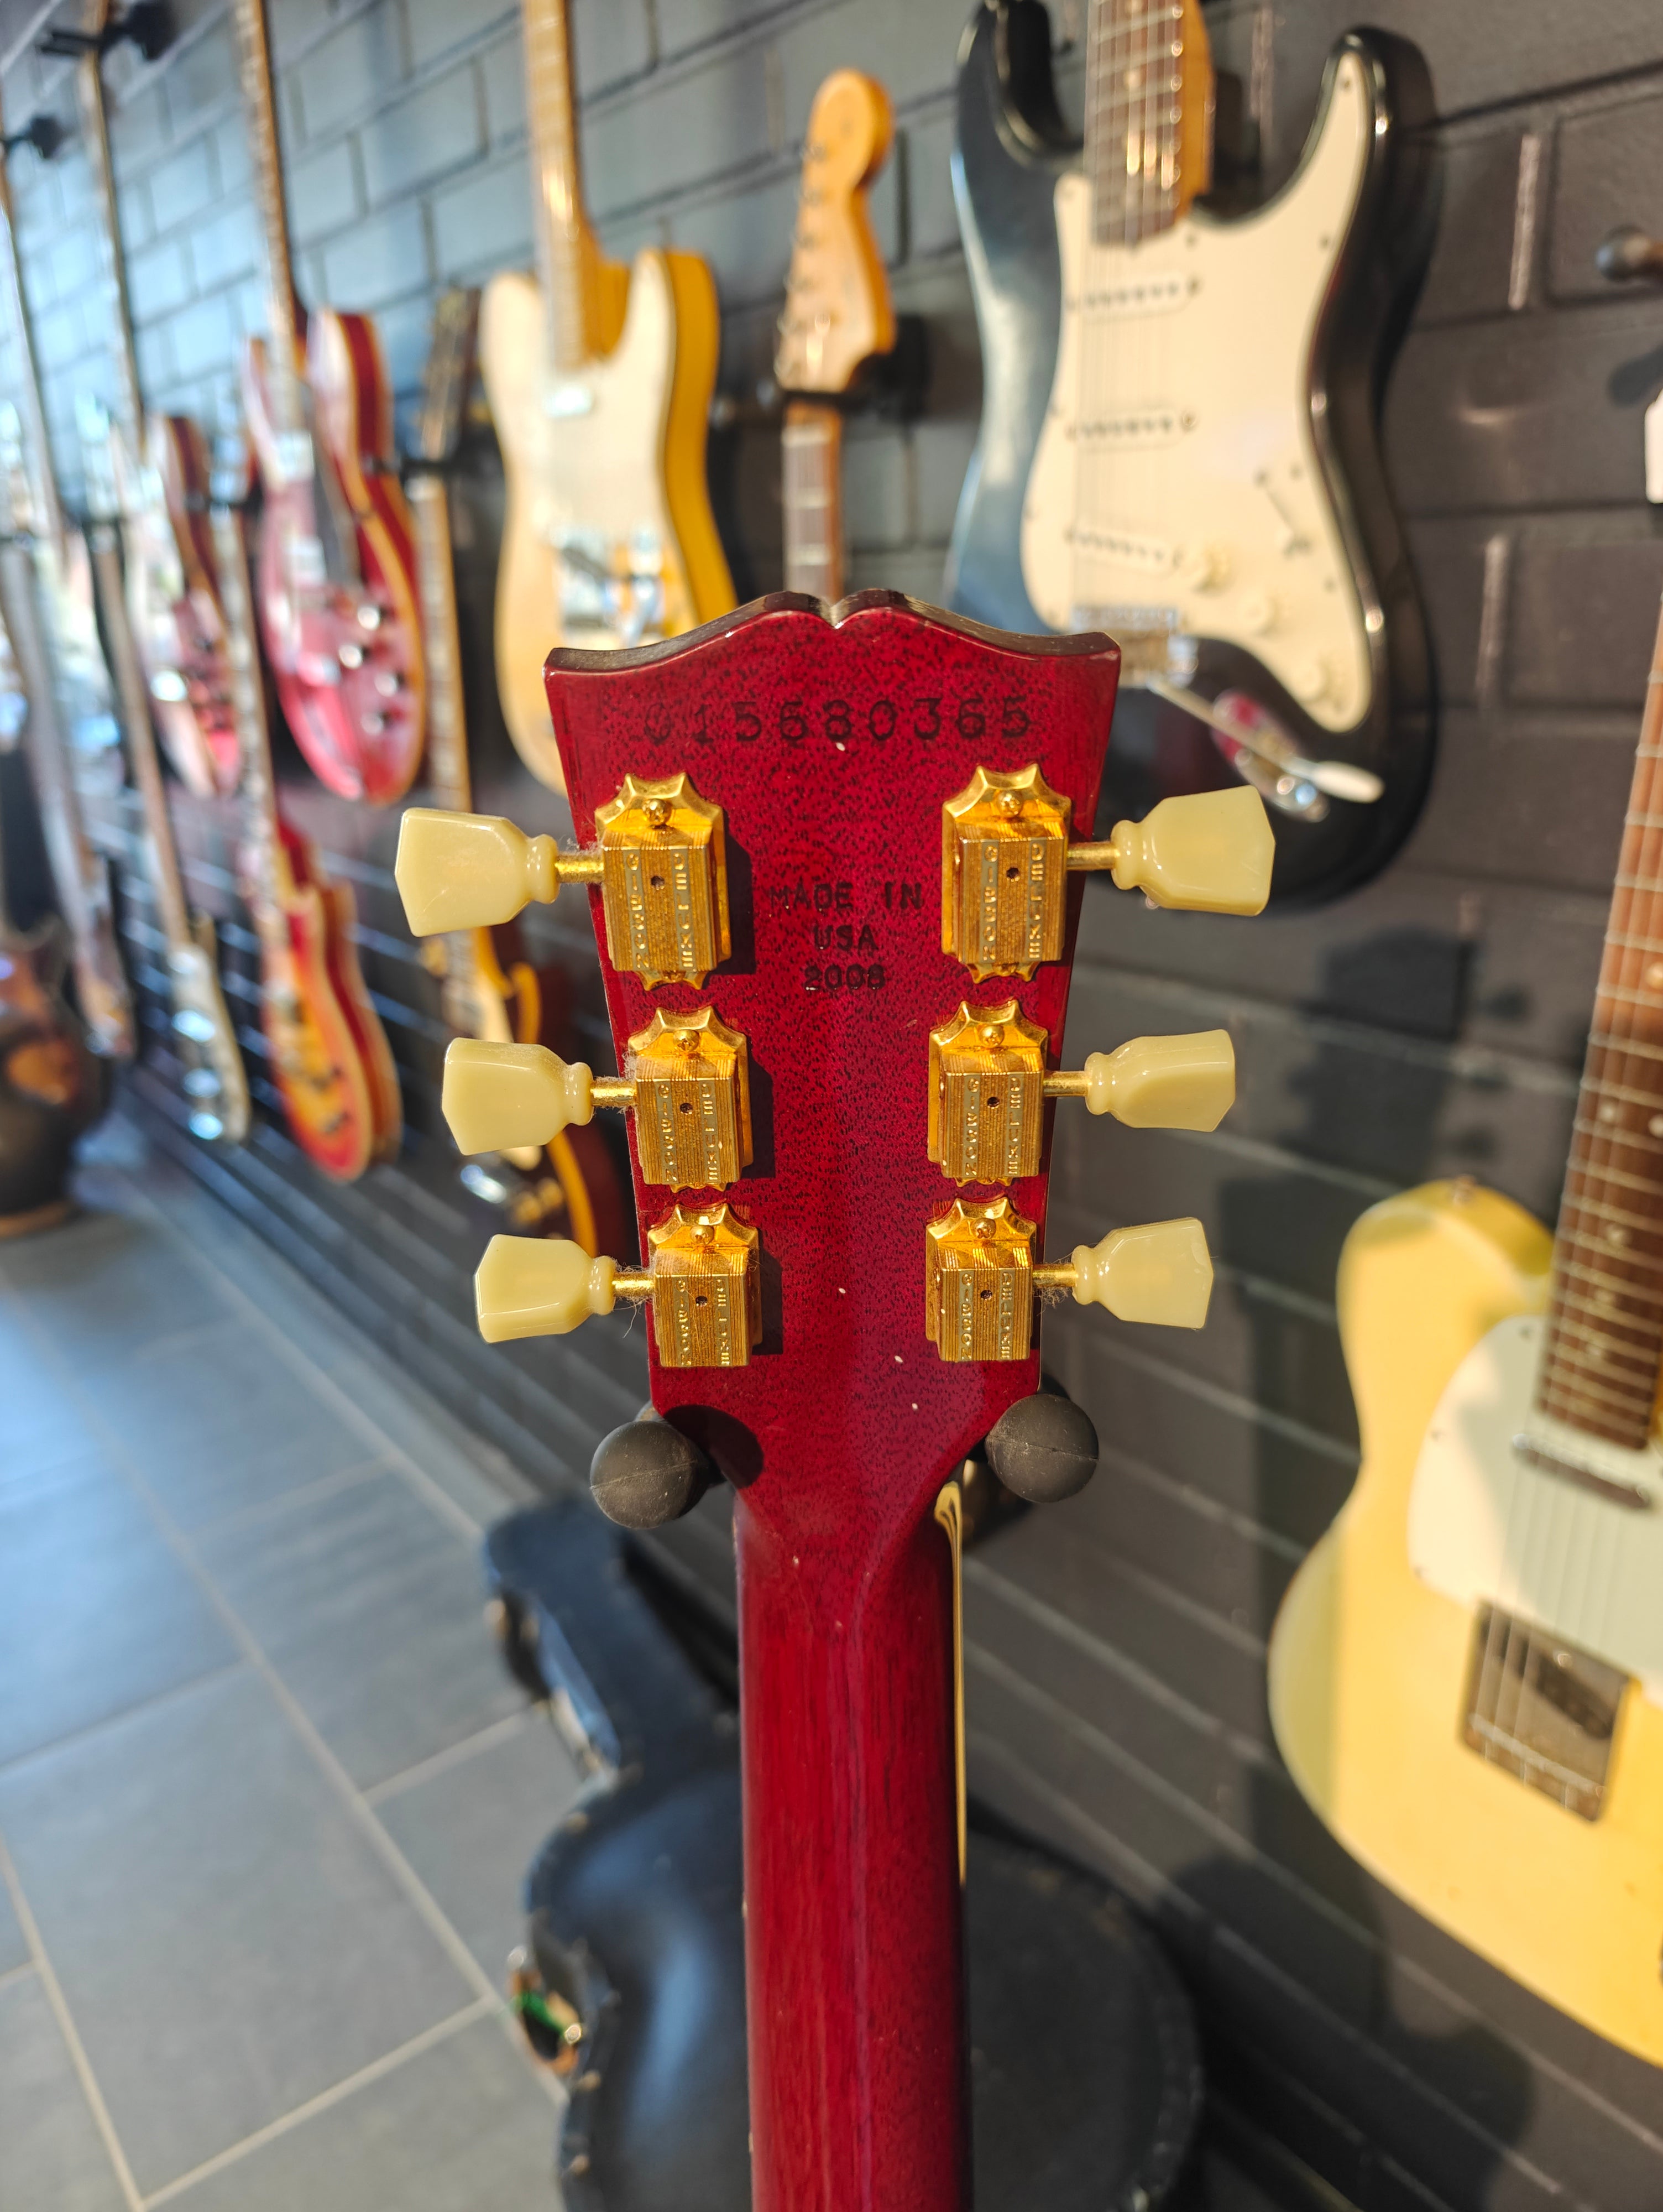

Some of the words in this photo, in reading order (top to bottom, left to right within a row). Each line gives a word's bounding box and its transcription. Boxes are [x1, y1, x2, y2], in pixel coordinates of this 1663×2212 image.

[626, 852, 650, 968] GIBSON
[673, 852, 694, 968] DELUXE
[769, 880, 853, 910] MADE
[885, 881, 922, 910] IN
[813, 923, 879, 952] USA
[982, 846, 998, 961] GIBSON
[1028, 842, 1044, 958] DELUXE
[803, 963, 886, 990] 2008
[658, 1084, 678, 1182] GIBSON
[702, 1083, 718, 1180] DELUXE
[965, 1078, 980, 1176] GIBSON
[1008, 1077, 1021, 1175] DELUXE
[676, 1280, 692, 1365] GIBSON
[716, 1279, 730, 1365] DELUXE
[961, 1273, 972, 1360] GIBSON
[1000, 1272, 1013, 1359] DELUXE
